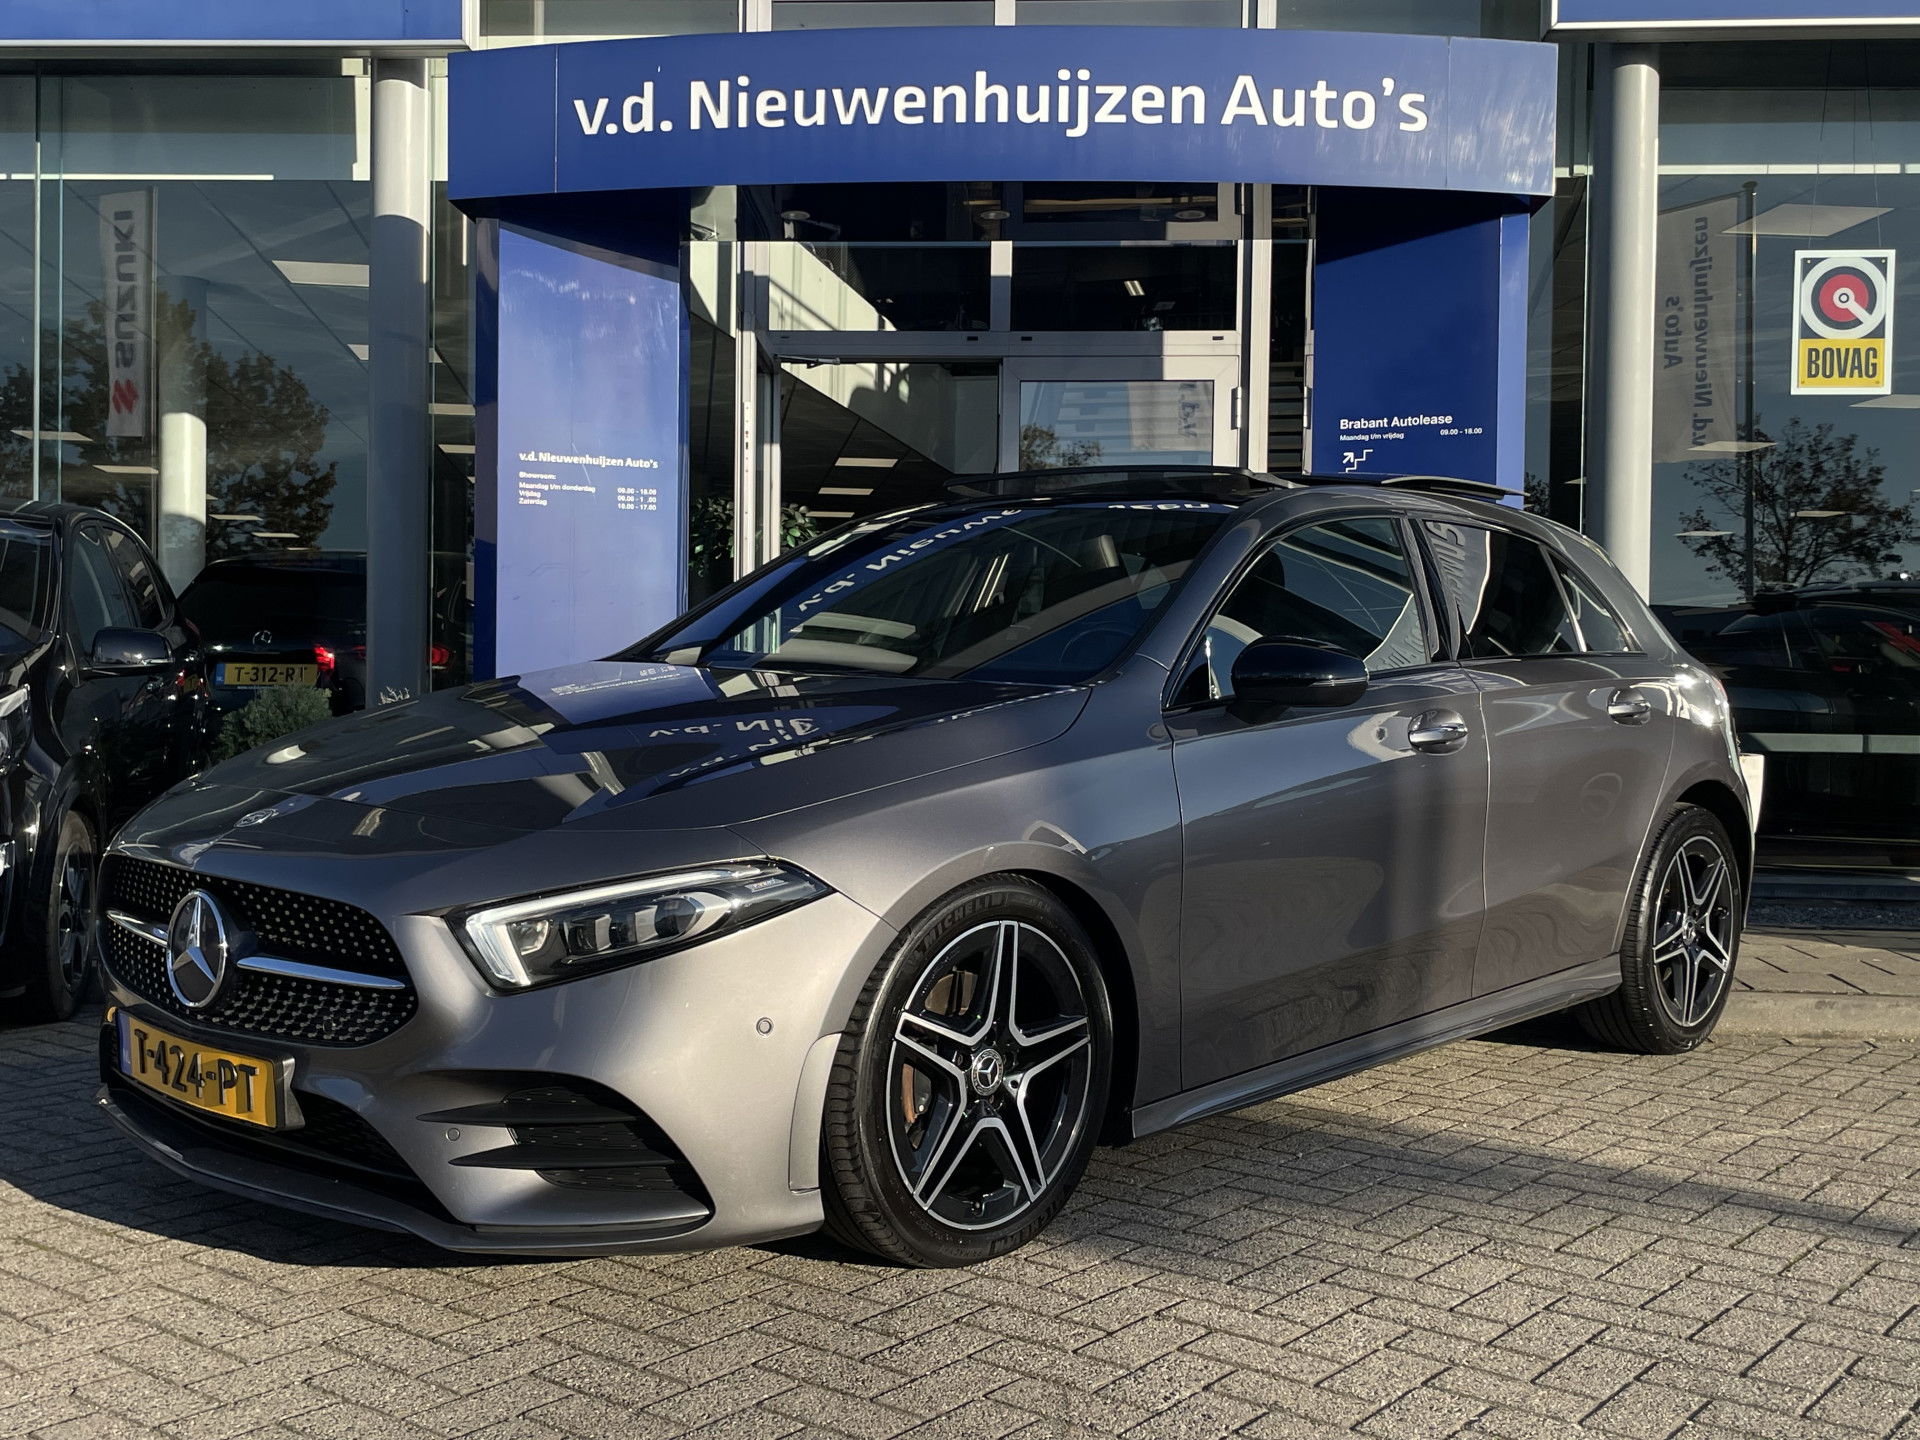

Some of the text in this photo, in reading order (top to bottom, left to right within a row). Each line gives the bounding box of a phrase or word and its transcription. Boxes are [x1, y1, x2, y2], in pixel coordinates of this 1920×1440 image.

[574, 69, 1428, 137] v.d. Nieuwenhuijzen Auto's
[1807, 347, 1878, 378] BOVAG
[1340, 414, 1453, 430] Brabant Autolease
[1339, 434, 1369, 442] Maandag
[1383, 432, 1405, 440] vrijdag
[519, 451, 659, 469] v.d. Nieuwenhuijzen Auto's
[519, 482, 549, 491] Maandag
[561, 484, 596, 493] donderdag
[519, 490, 541, 498] Vrijdag
[518, 498, 548, 506] Zaterdag
[134, 1028, 260, 1113] T-424-PT
